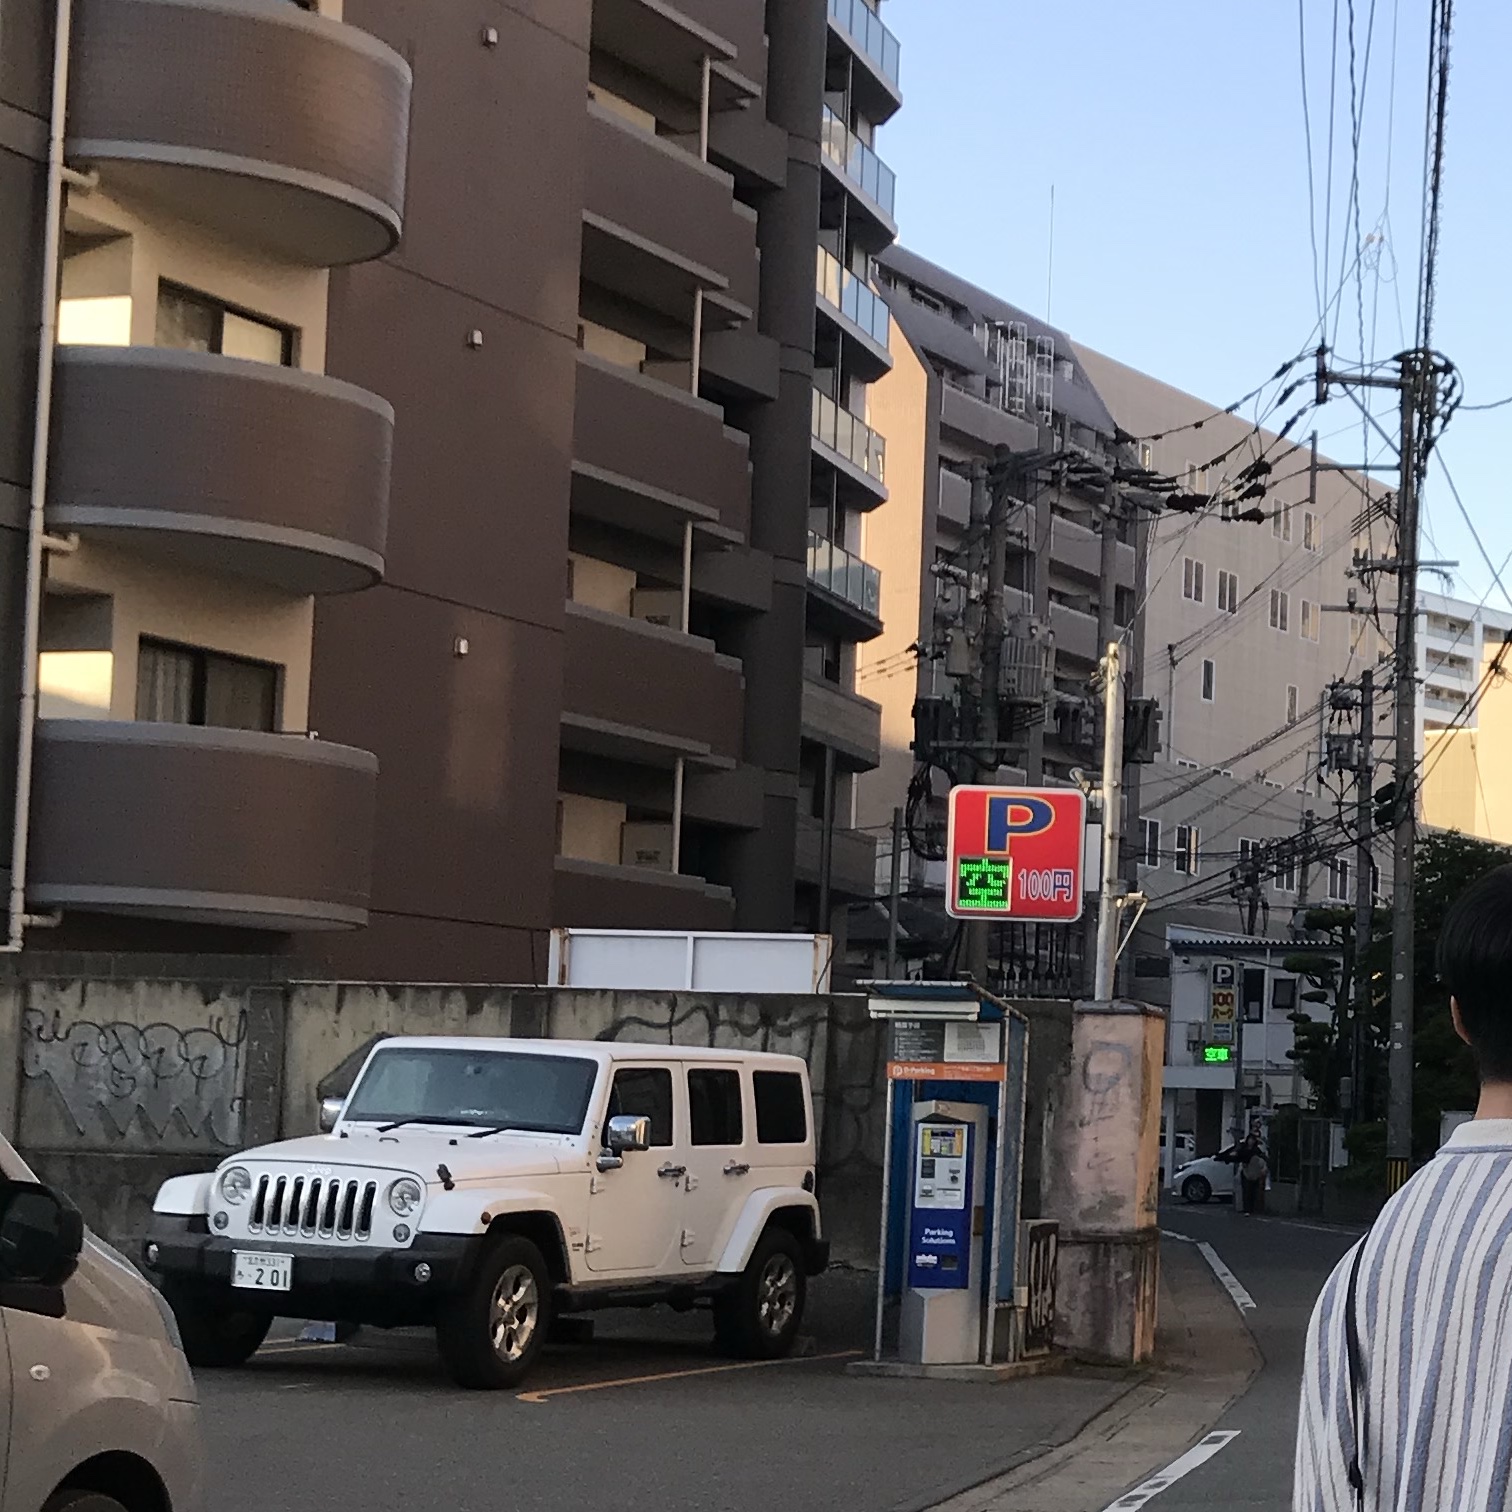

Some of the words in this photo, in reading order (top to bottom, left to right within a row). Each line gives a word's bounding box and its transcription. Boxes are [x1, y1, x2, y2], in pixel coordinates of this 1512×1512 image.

[984, 794, 1056, 855] P
[959, 858, 1010, 908] 空
[1018, 868, 1074, 903] 100円
[1216, 966, 1232, 983] P
[1213, 992, 1234, 1006] 100
[921, 1236, 956, 1245] Solutions
[924, 1228, 954, 1238] Parking
